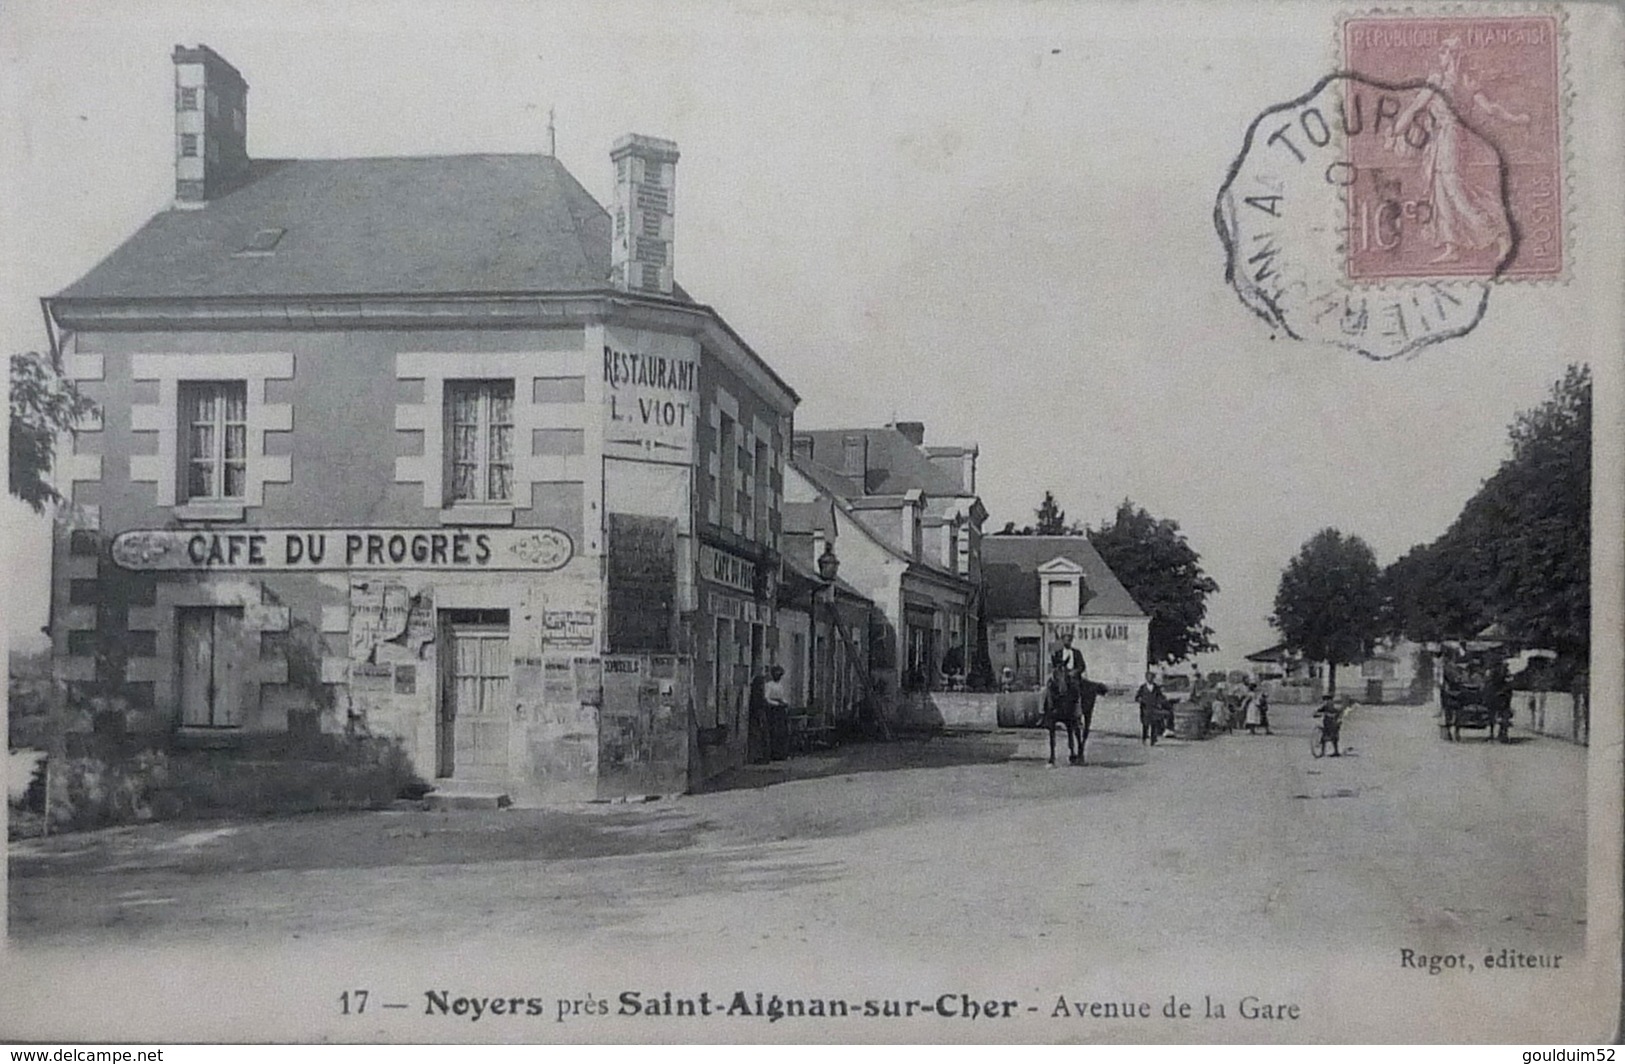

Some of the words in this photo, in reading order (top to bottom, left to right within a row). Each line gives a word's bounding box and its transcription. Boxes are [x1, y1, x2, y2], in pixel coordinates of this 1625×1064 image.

[603, 345, 695, 391] RESTAURANT
[638, 397, 690, 428] VIOT
[286, 534, 325, 564] DU
